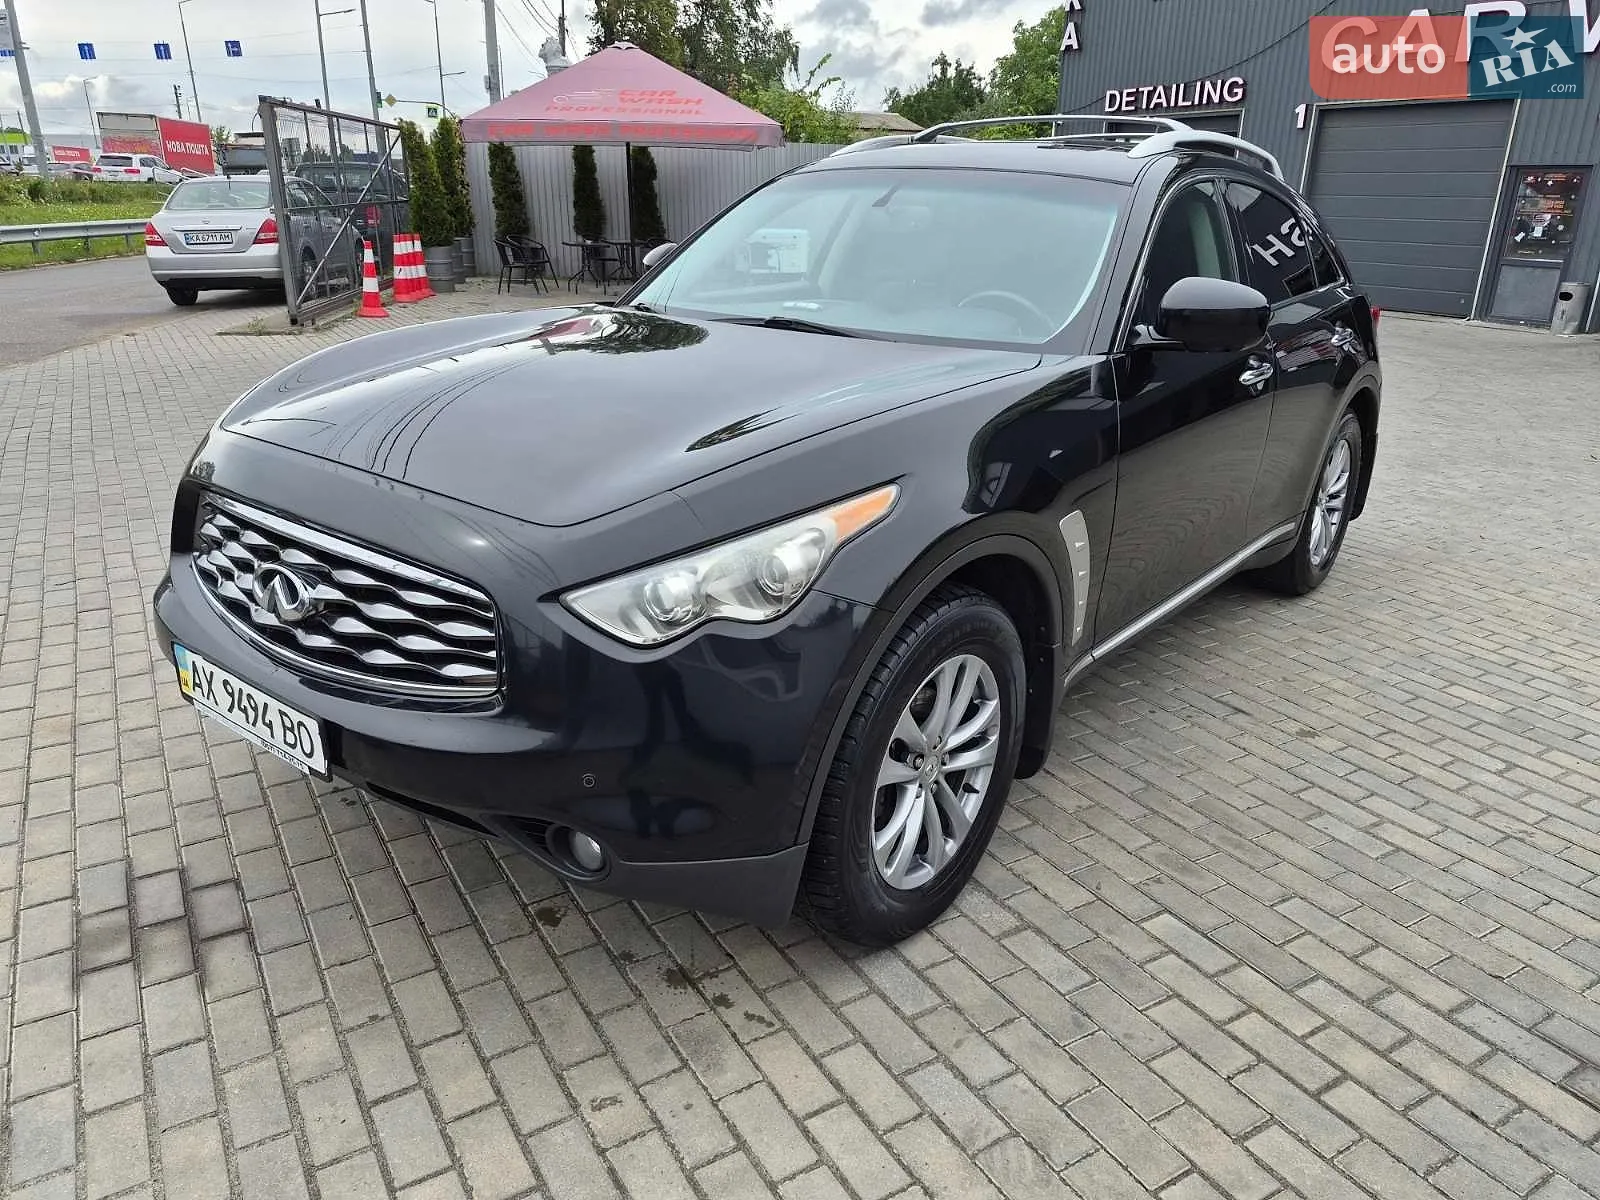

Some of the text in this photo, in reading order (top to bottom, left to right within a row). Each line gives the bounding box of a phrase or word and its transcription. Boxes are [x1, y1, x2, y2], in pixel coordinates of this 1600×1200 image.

[618, 88, 677, 97] CAR
[1104, 77, 1245, 112] DETAILING
[1294, 103, 1307, 129] 1
[166, 140, 186, 154] НОВА
[191, 660, 219, 706] AX
[222, 678, 275, 740] 9494
[278, 708, 315, 759] BO
